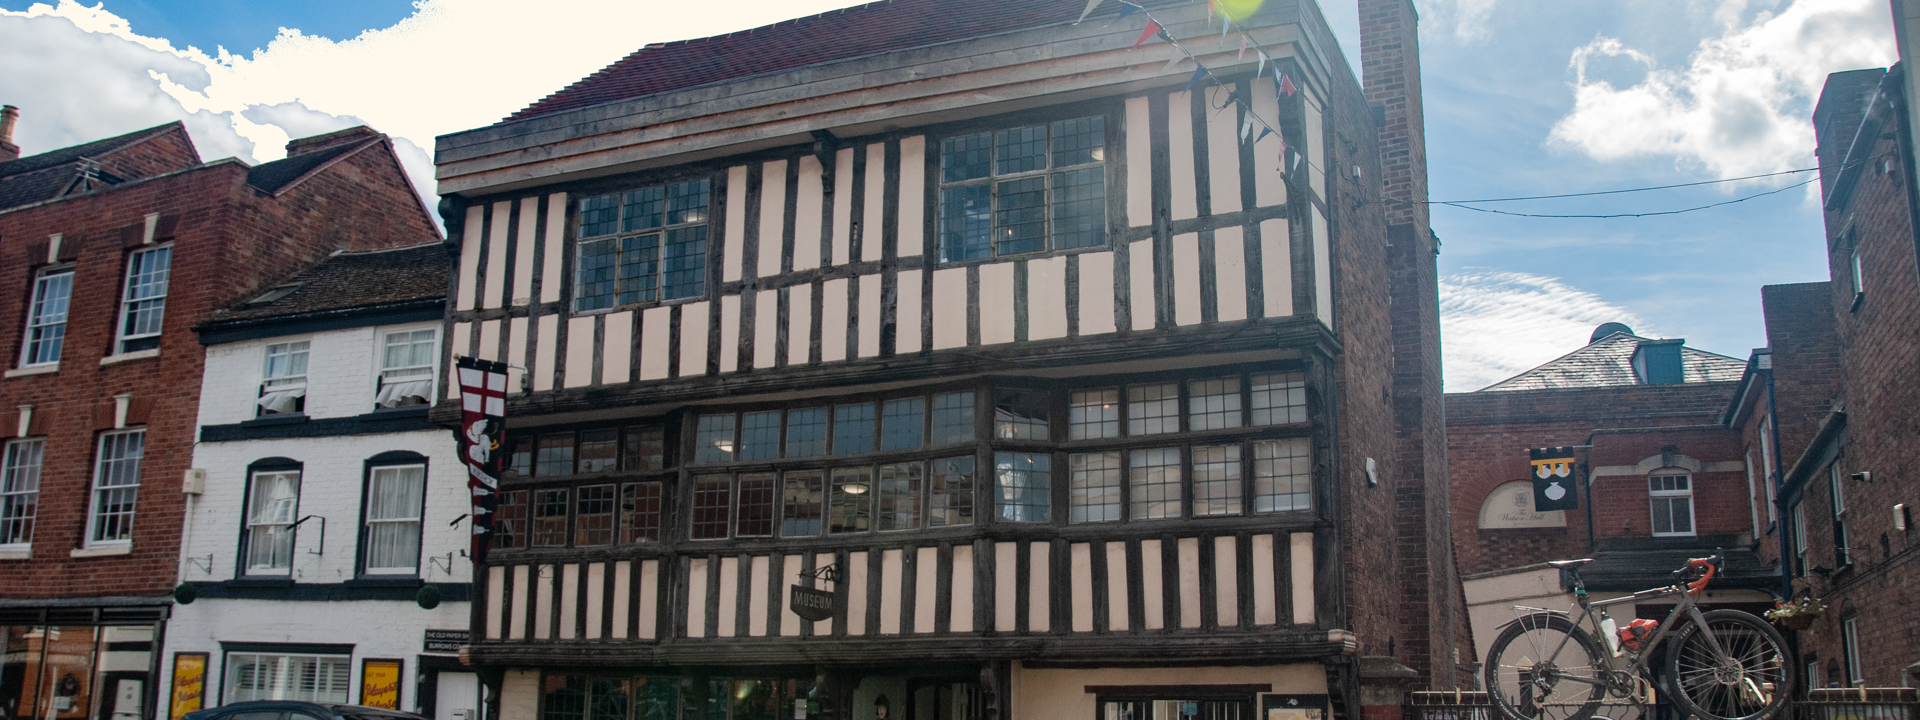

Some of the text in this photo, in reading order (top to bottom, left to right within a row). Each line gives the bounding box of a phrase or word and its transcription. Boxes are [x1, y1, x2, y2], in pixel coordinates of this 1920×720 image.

[1498, 512, 1546, 521] Watson Hall
[794, 591, 833, 610] MUSEUM
